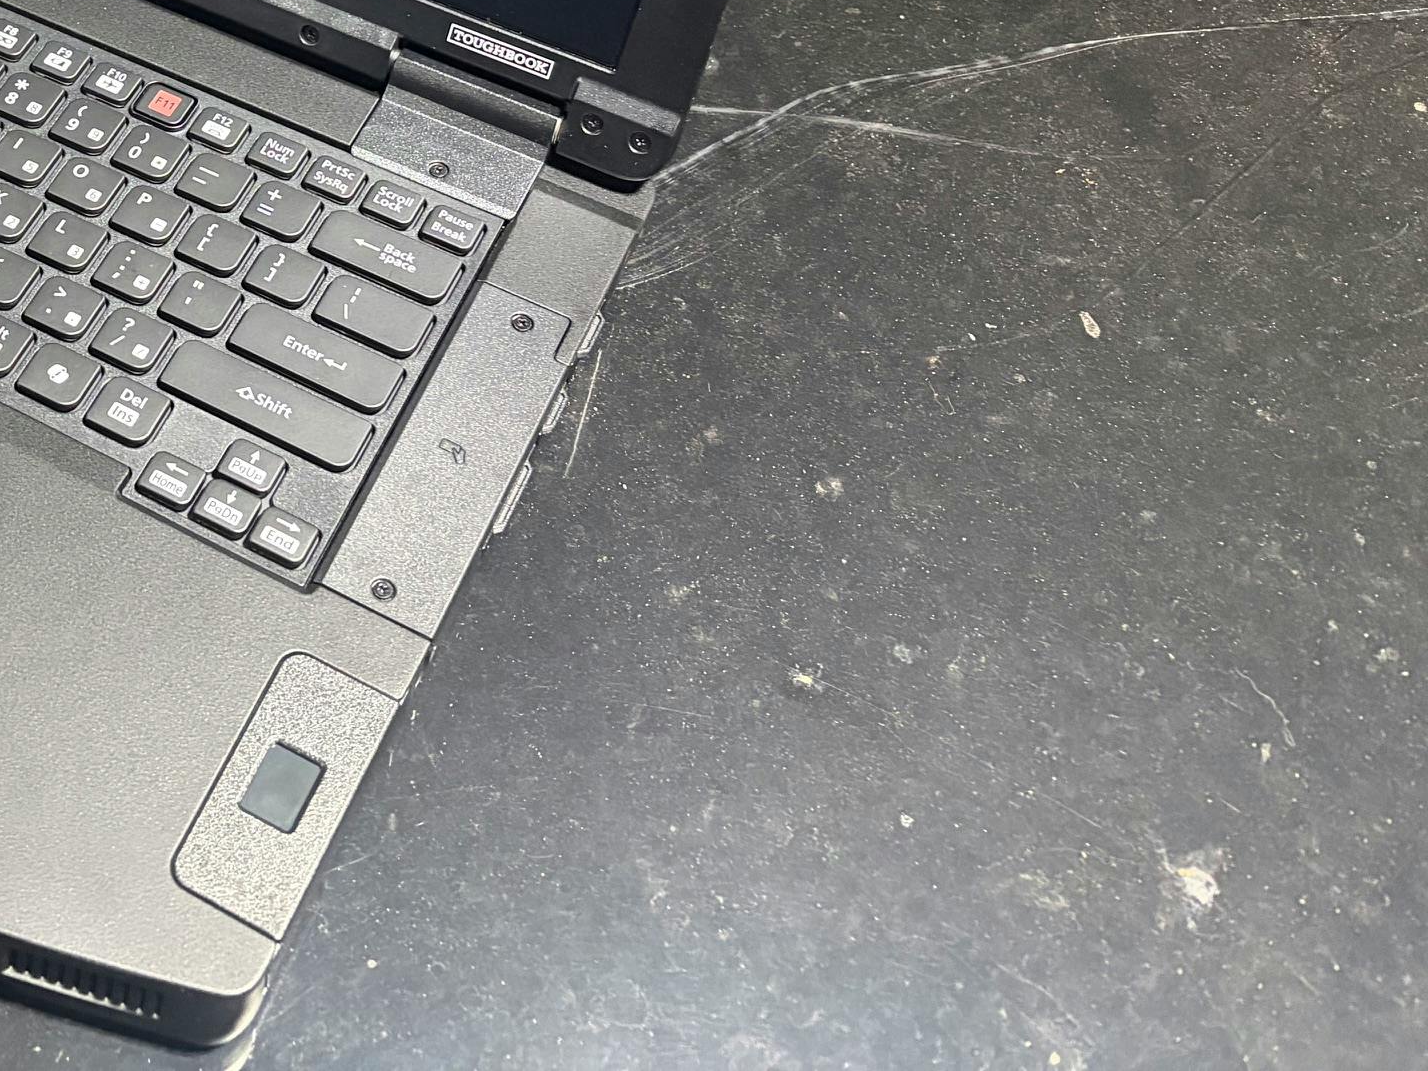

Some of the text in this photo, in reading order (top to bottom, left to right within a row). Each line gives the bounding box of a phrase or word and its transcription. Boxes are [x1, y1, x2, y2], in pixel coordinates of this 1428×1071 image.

[3, 24, 20, 36] F8
[57, 46, 73, 59] F9
[453, 28, 549, 75] TOUGHBOOK
[106, 67, 128, 82] F10
[4, 91, 19, 105] 8
[155, 96, 176, 110] F11
[77, 105, 88, 117] (
[212, 113, 233, 128] F12
[65, 118, 80, 131] 9
[139, 132, 150, 144] )
[265, 137, 295, 157] Num
[260, 146, 289, 165] Lock
[72, 164, 89, 178] O
[321, 159, 356, 181] PrtSc
[313, 171, 349, 194] SysRq
[136, 192, 153, 205] P
[267, 188, 282, 201] +
[379, 185, 415, 208] Scroll
[256, 202, 275, 216] =
[373, 195, 404, 215] Lock
[55, 219, 67, 234] L
[438, 209, 474, 231] Pause
[430, 221, 467, 244] Break
[379, 251, 417, 275] space
[383, 242, 417, 264] Back
[122, 317, 136, 332] ?
[282, 334, 324, 362] Enter
[119, 387, 149, 410] Del
[253, 392, 293, 421] Shift
[112, 404, 134, 424] Ins
[231, 459, 264, 484] PgUp
[152, 471, 184, 495] Home
[207, 500, 239, 524] PgDn
[265, 529, 295, 552] End
